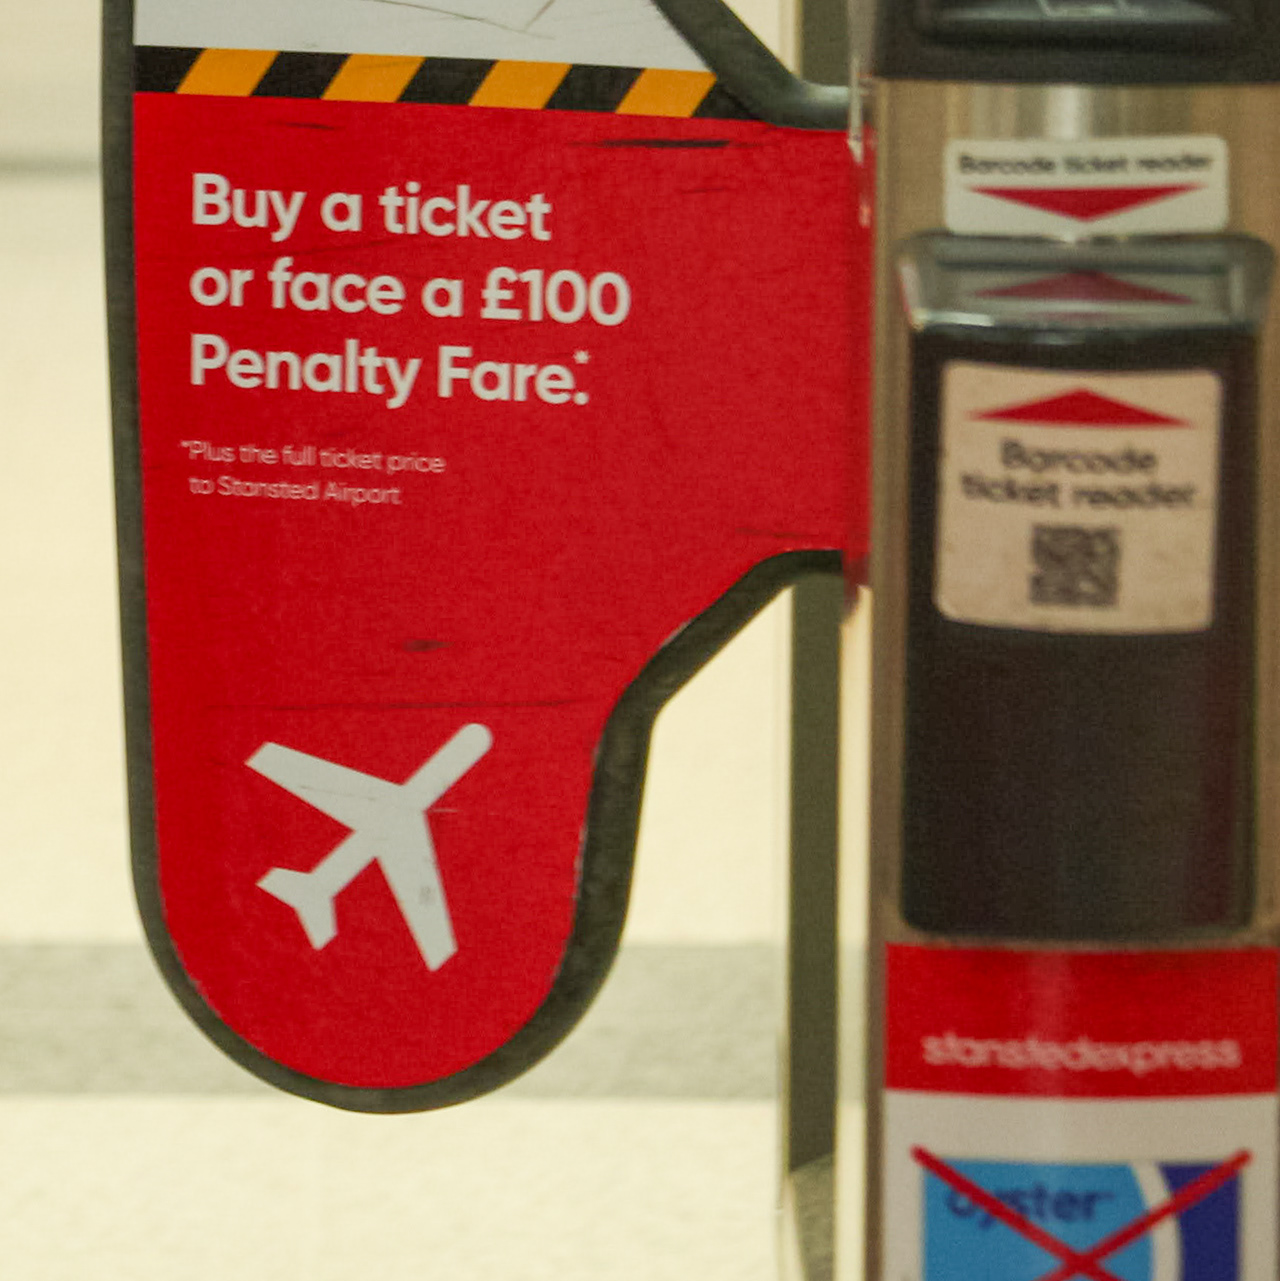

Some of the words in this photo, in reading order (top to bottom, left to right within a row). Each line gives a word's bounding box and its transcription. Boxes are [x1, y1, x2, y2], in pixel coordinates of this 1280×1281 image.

[191, 173, 307, 243] Buy
[320, 191, 363, 232] a
[378, 181, 552, 241] ticket
[189, 266, 254, 307] or
[267, 256, 406, 315] face
[422, 277, 464, 317] a
[480, 266, 632, 326] £100
[190, 333, 422, 409] Penalty
[240, 444, 279, 465] the
[282, 445, 317, 466] full
[319, 448, 383, 470] ticket
[386, 452, 447, 474] price
[1001, 439, 1157, 473] Barcode
[188, 477, 215, 495] to
[217, 475, 320, 501] Stansted
[324, 482, 402, 507] Airport
